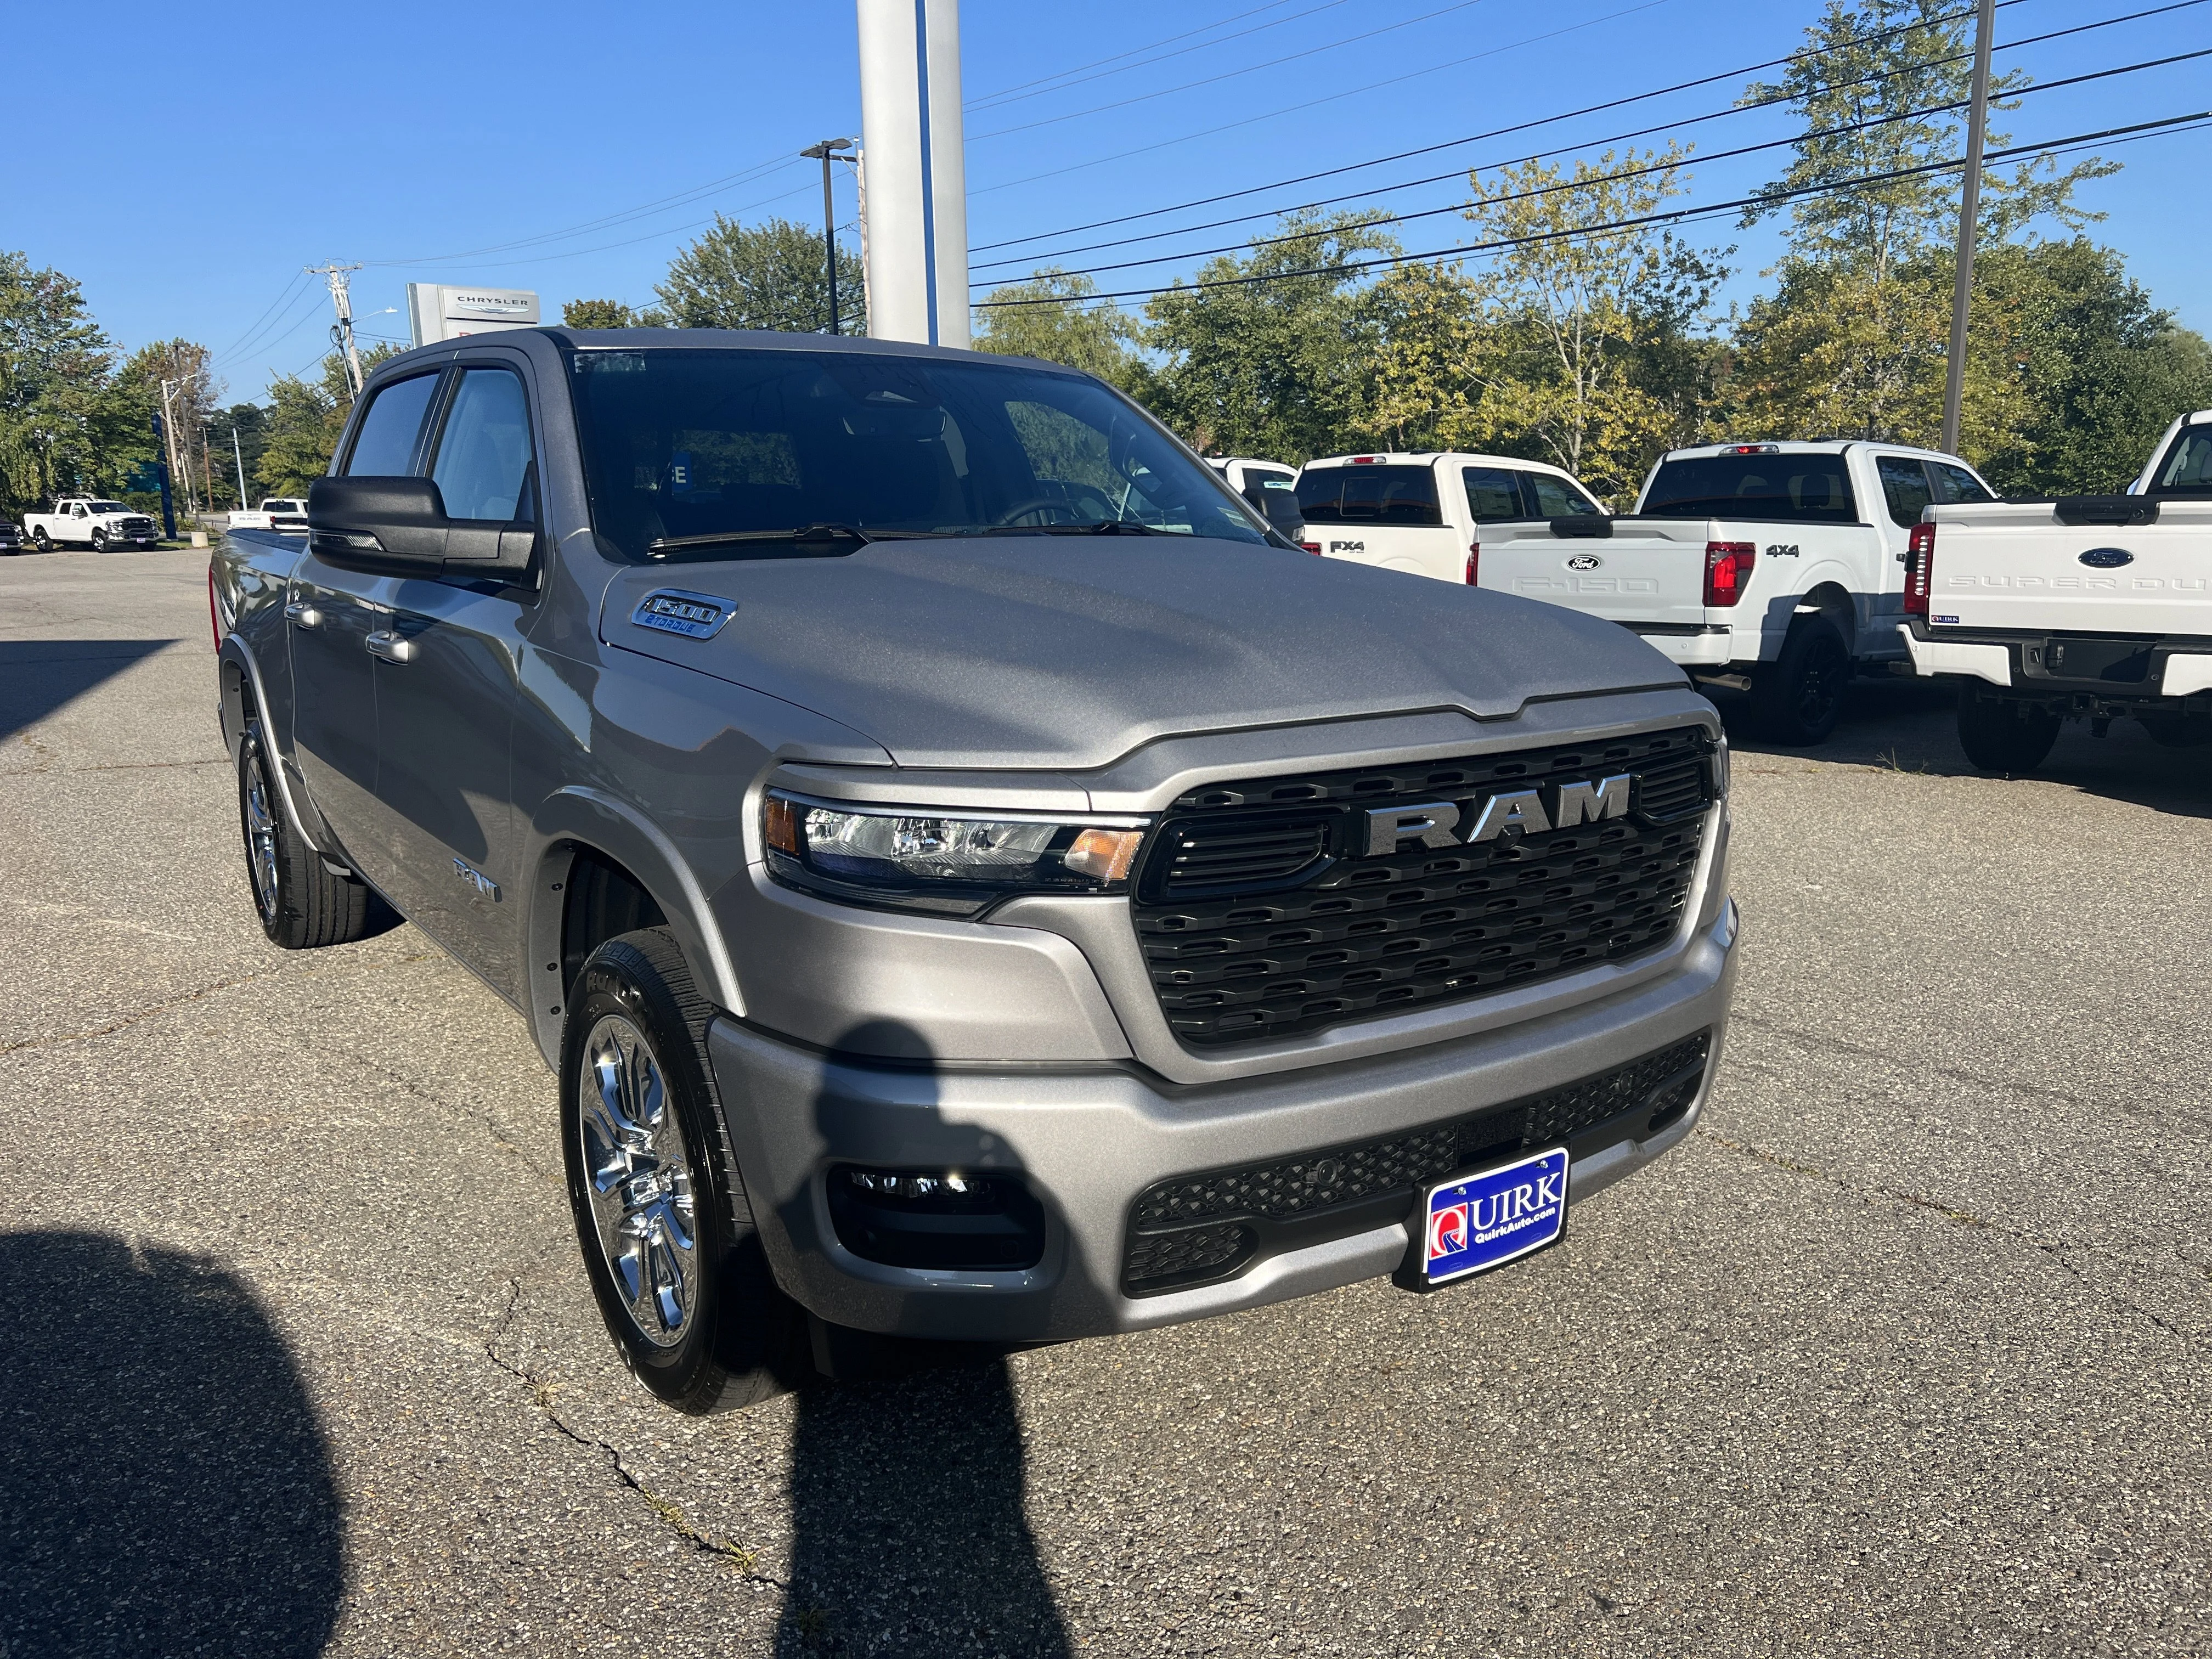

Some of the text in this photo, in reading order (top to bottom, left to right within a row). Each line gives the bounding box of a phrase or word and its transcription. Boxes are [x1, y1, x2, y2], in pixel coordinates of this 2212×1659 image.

[458, 296, 528, 306] CHRYSLER
[672, 467, 686, 483] E
[1330, 541, 1364, 553] FX4
[1572, 557, 1595, 569] Ford
[2089, 552, 2120, 564] Ford
[1513, 577, 1658, 594] F-150
[1949, 576, 2212, 591] SUPER DU
[652, 599, 718, 623] 1500
[1363, 774, 1630, 857] RAM
[1432, 1172, 1561, 1254] QUIRK
[1475, 1207, 1556, 1244] QuirkAuto.com
